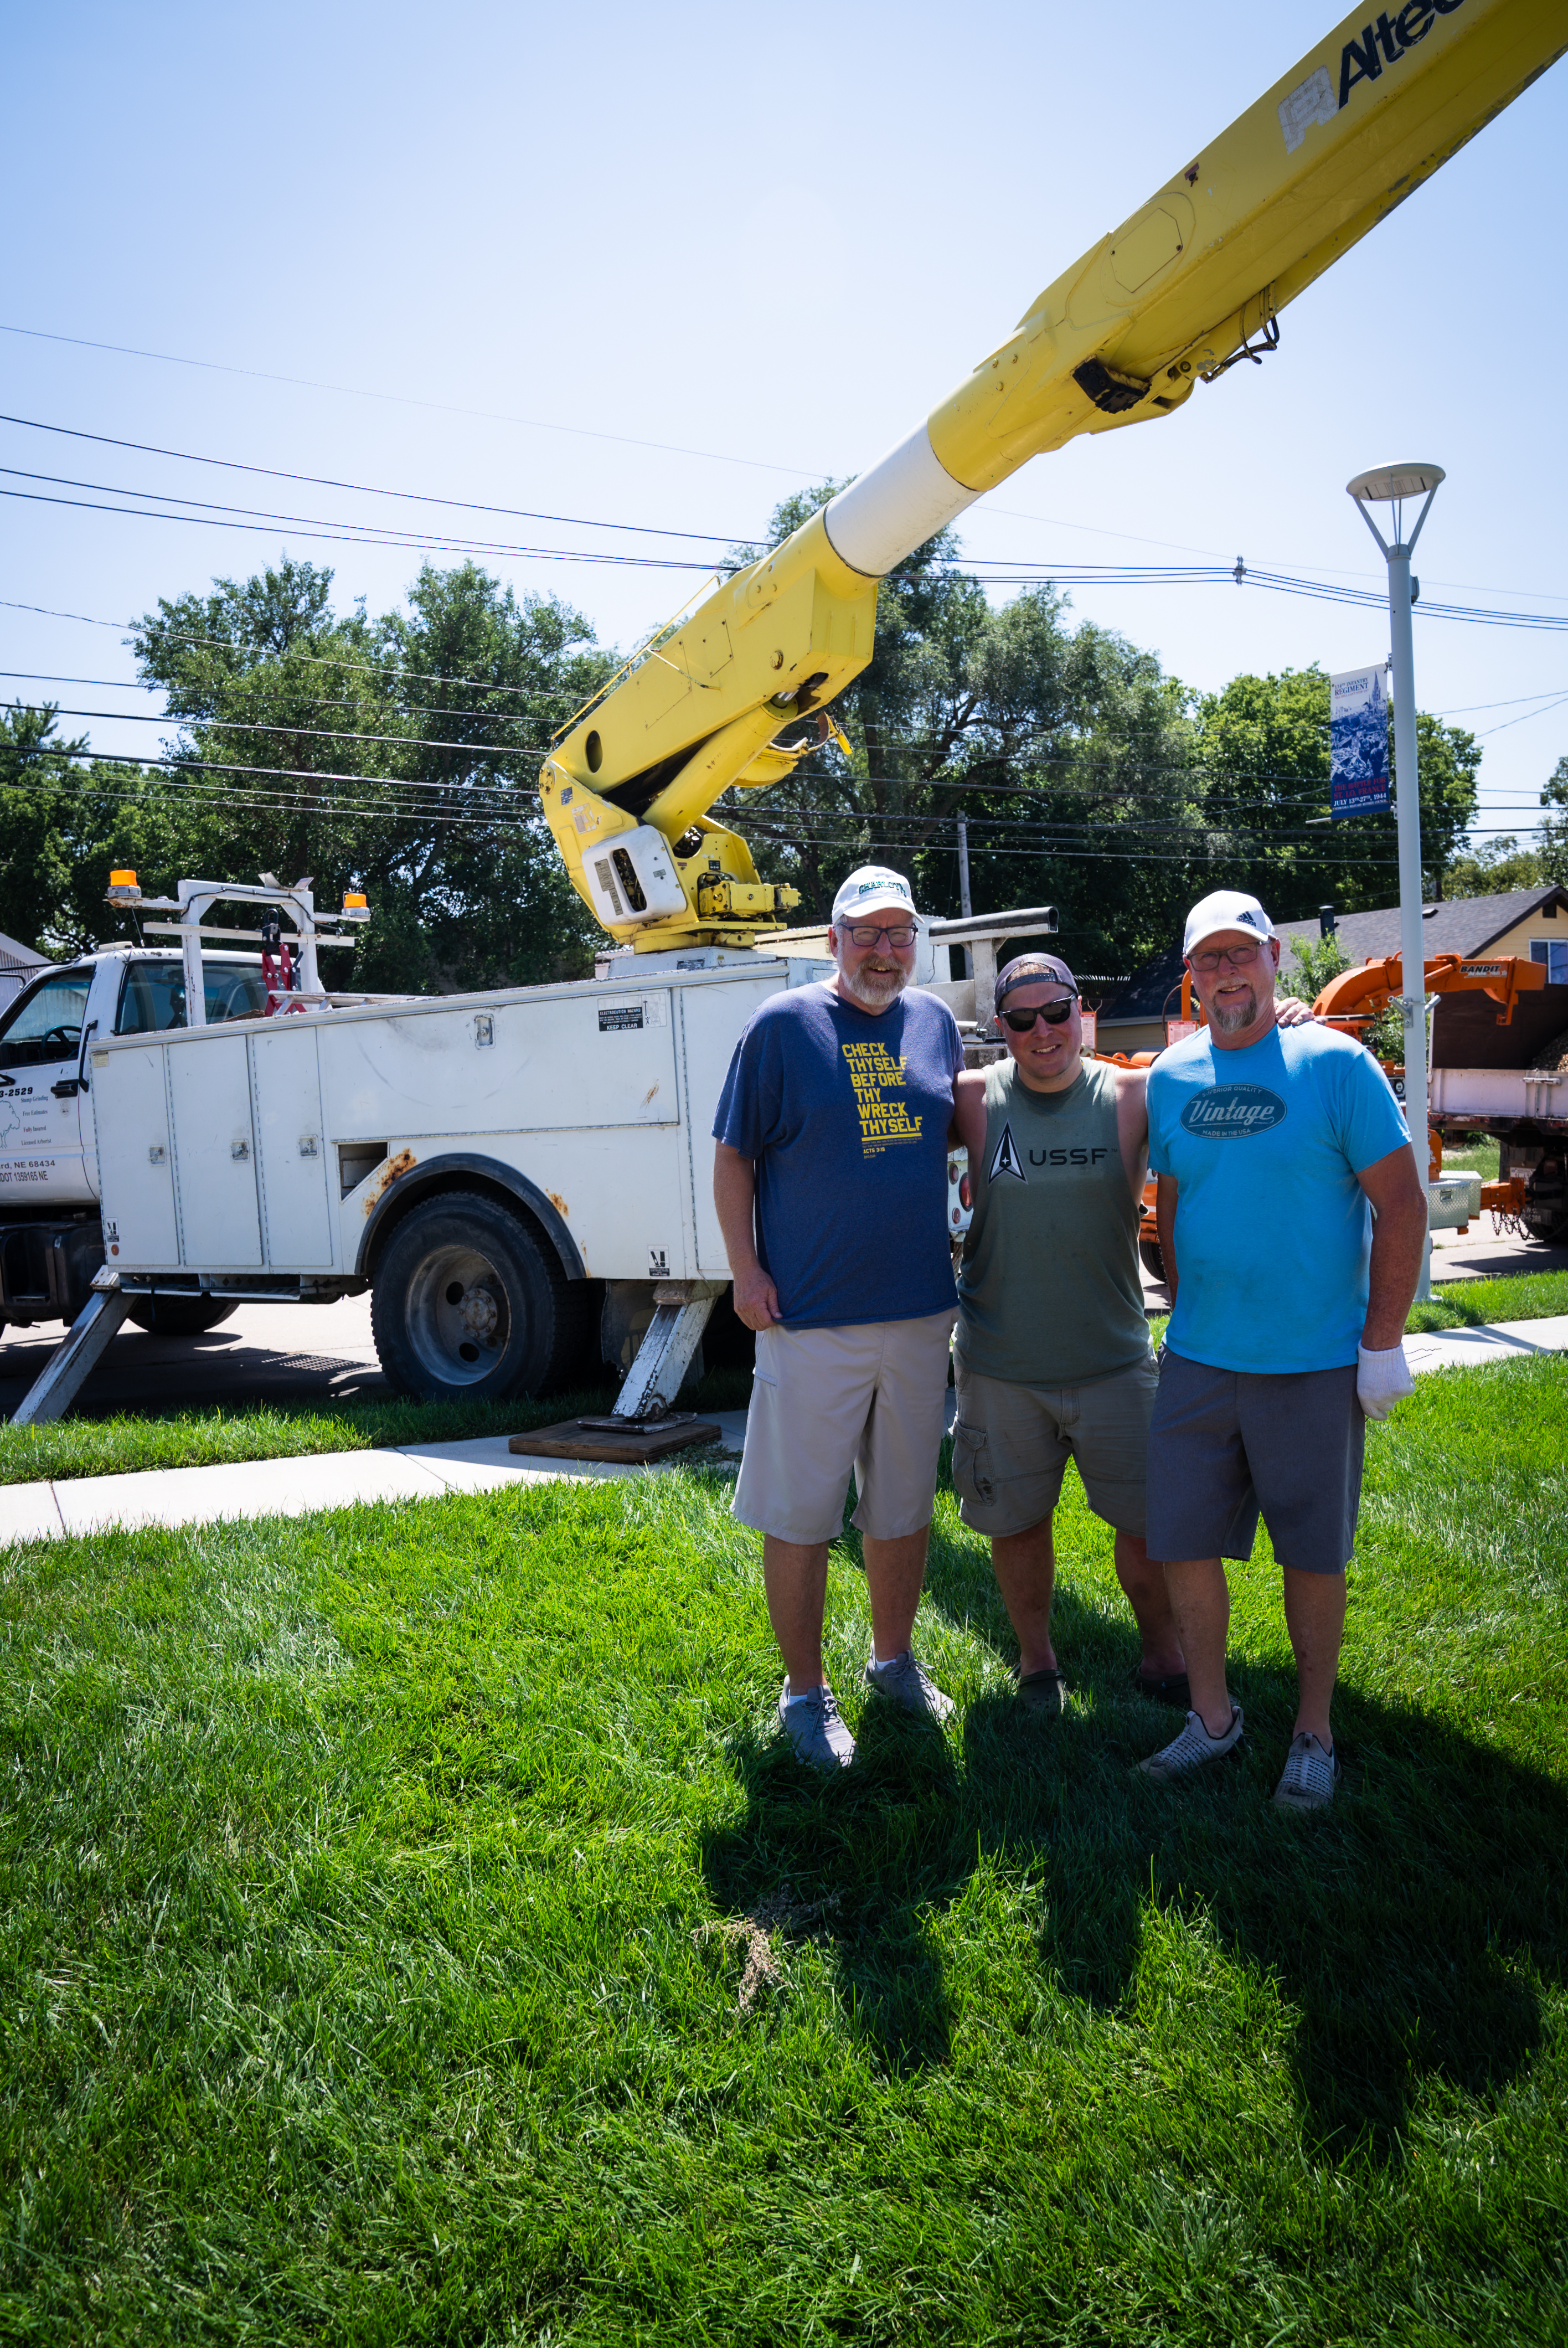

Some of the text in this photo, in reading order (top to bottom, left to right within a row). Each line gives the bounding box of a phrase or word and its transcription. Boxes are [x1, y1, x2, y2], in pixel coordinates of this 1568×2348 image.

[1347, 677, 1369, 686] INFANTRY
[1335, 682, 1369, 696] REGIMENT
[1348, 779, 1371, 789] BATTLE
[1374, 776, 1386, 785] FOR
[1358, 784, 1386, 796] FRANCE
[1236, 917, 1256, 927] adidas
[842, 1043, 889, 1057] CHECK
[846, 1056, 907, 1072] THYSELF
[850, 1072, 906, 1087] BEFORE
[854, 1088, 880, 1103] THY
[1202, 1086, 1262, 1097] SUPERIOR QUALITY
[857, 1102, 909, 1119] WRECK
[1189, 1097, 1275, 1126] Vintage
[859, 1116, 922, 1135] THYSELF
[1029, 1149, 1108, 1166] USSF
[0, 1171, 48, 1182] DOT 1359165 NE
